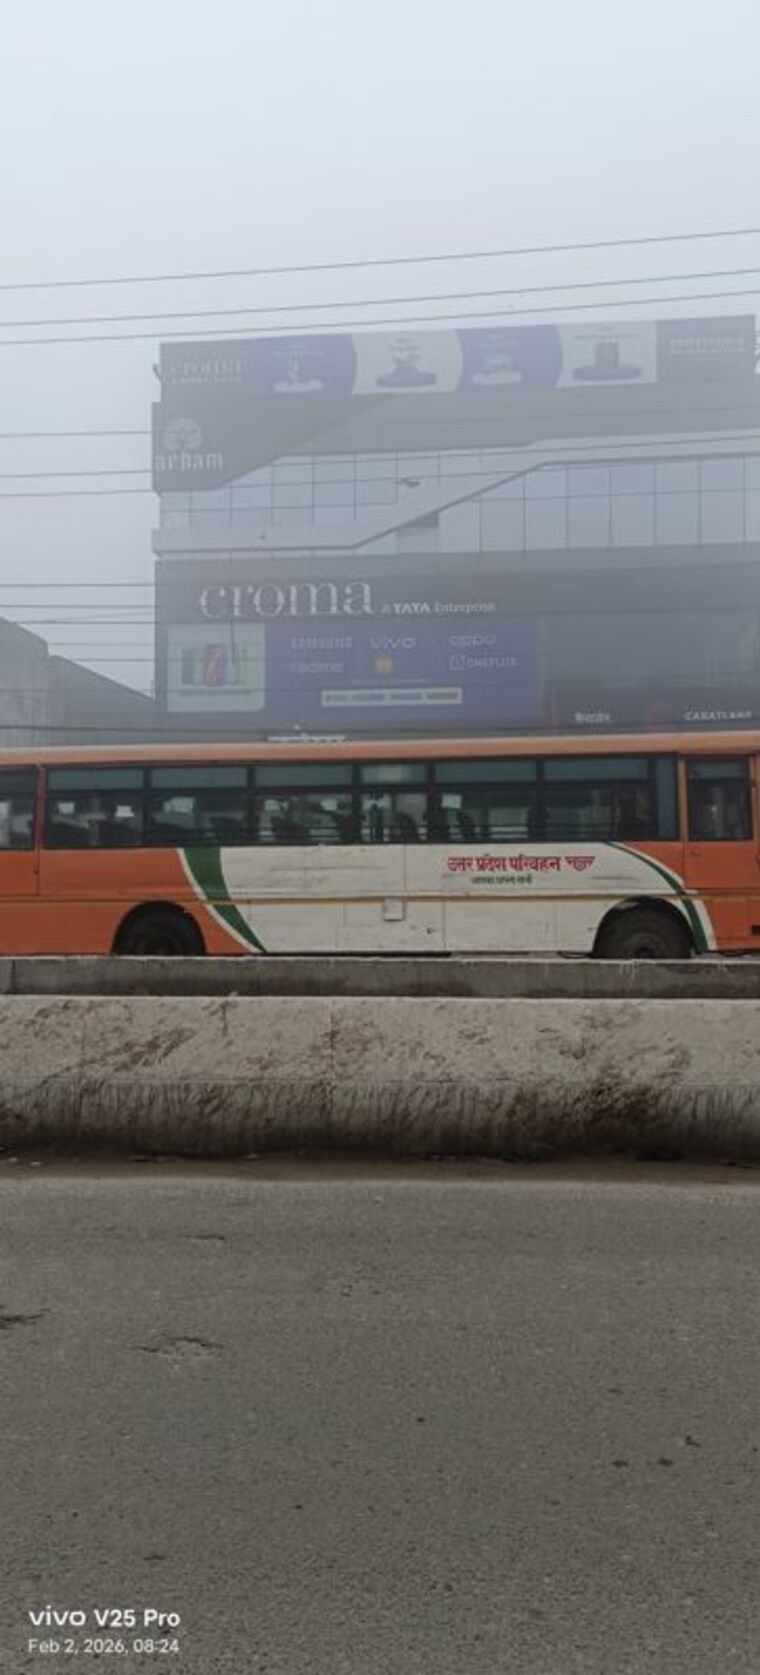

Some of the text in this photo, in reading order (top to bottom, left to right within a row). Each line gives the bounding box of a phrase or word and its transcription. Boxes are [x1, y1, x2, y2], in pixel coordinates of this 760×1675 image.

[154, 450, 223, 471] arham
[393, 602, 430, 614] TATA
[369, 636, 417, 649] vivo
